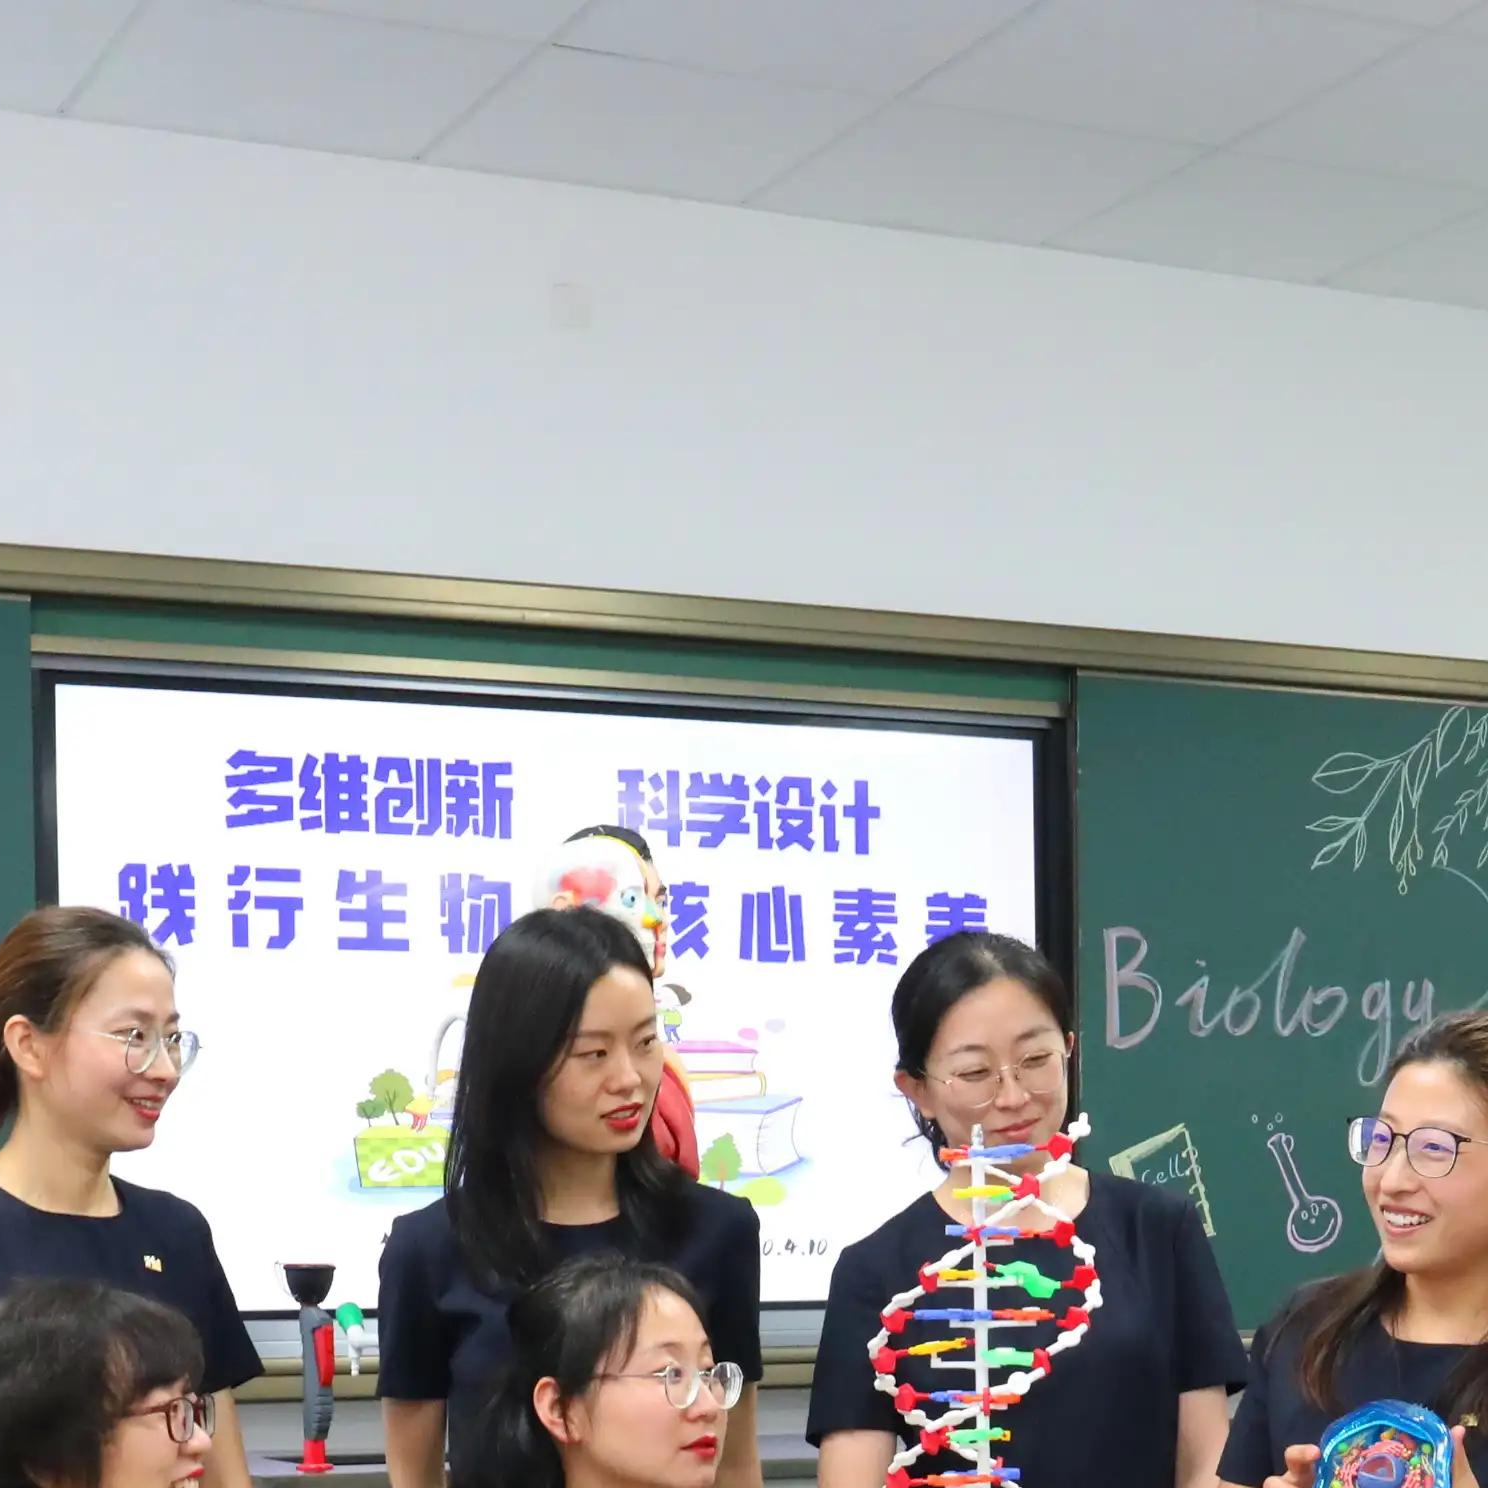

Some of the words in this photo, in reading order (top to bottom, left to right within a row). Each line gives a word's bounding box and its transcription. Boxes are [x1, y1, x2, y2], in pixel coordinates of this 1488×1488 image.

[225, 749, 513, 840] 多维创新
[618, 768, 881, 856] 科学设计
[1103, 926, 1435, 1087] Biology
[368, 1142, 446, 1182] EDU
